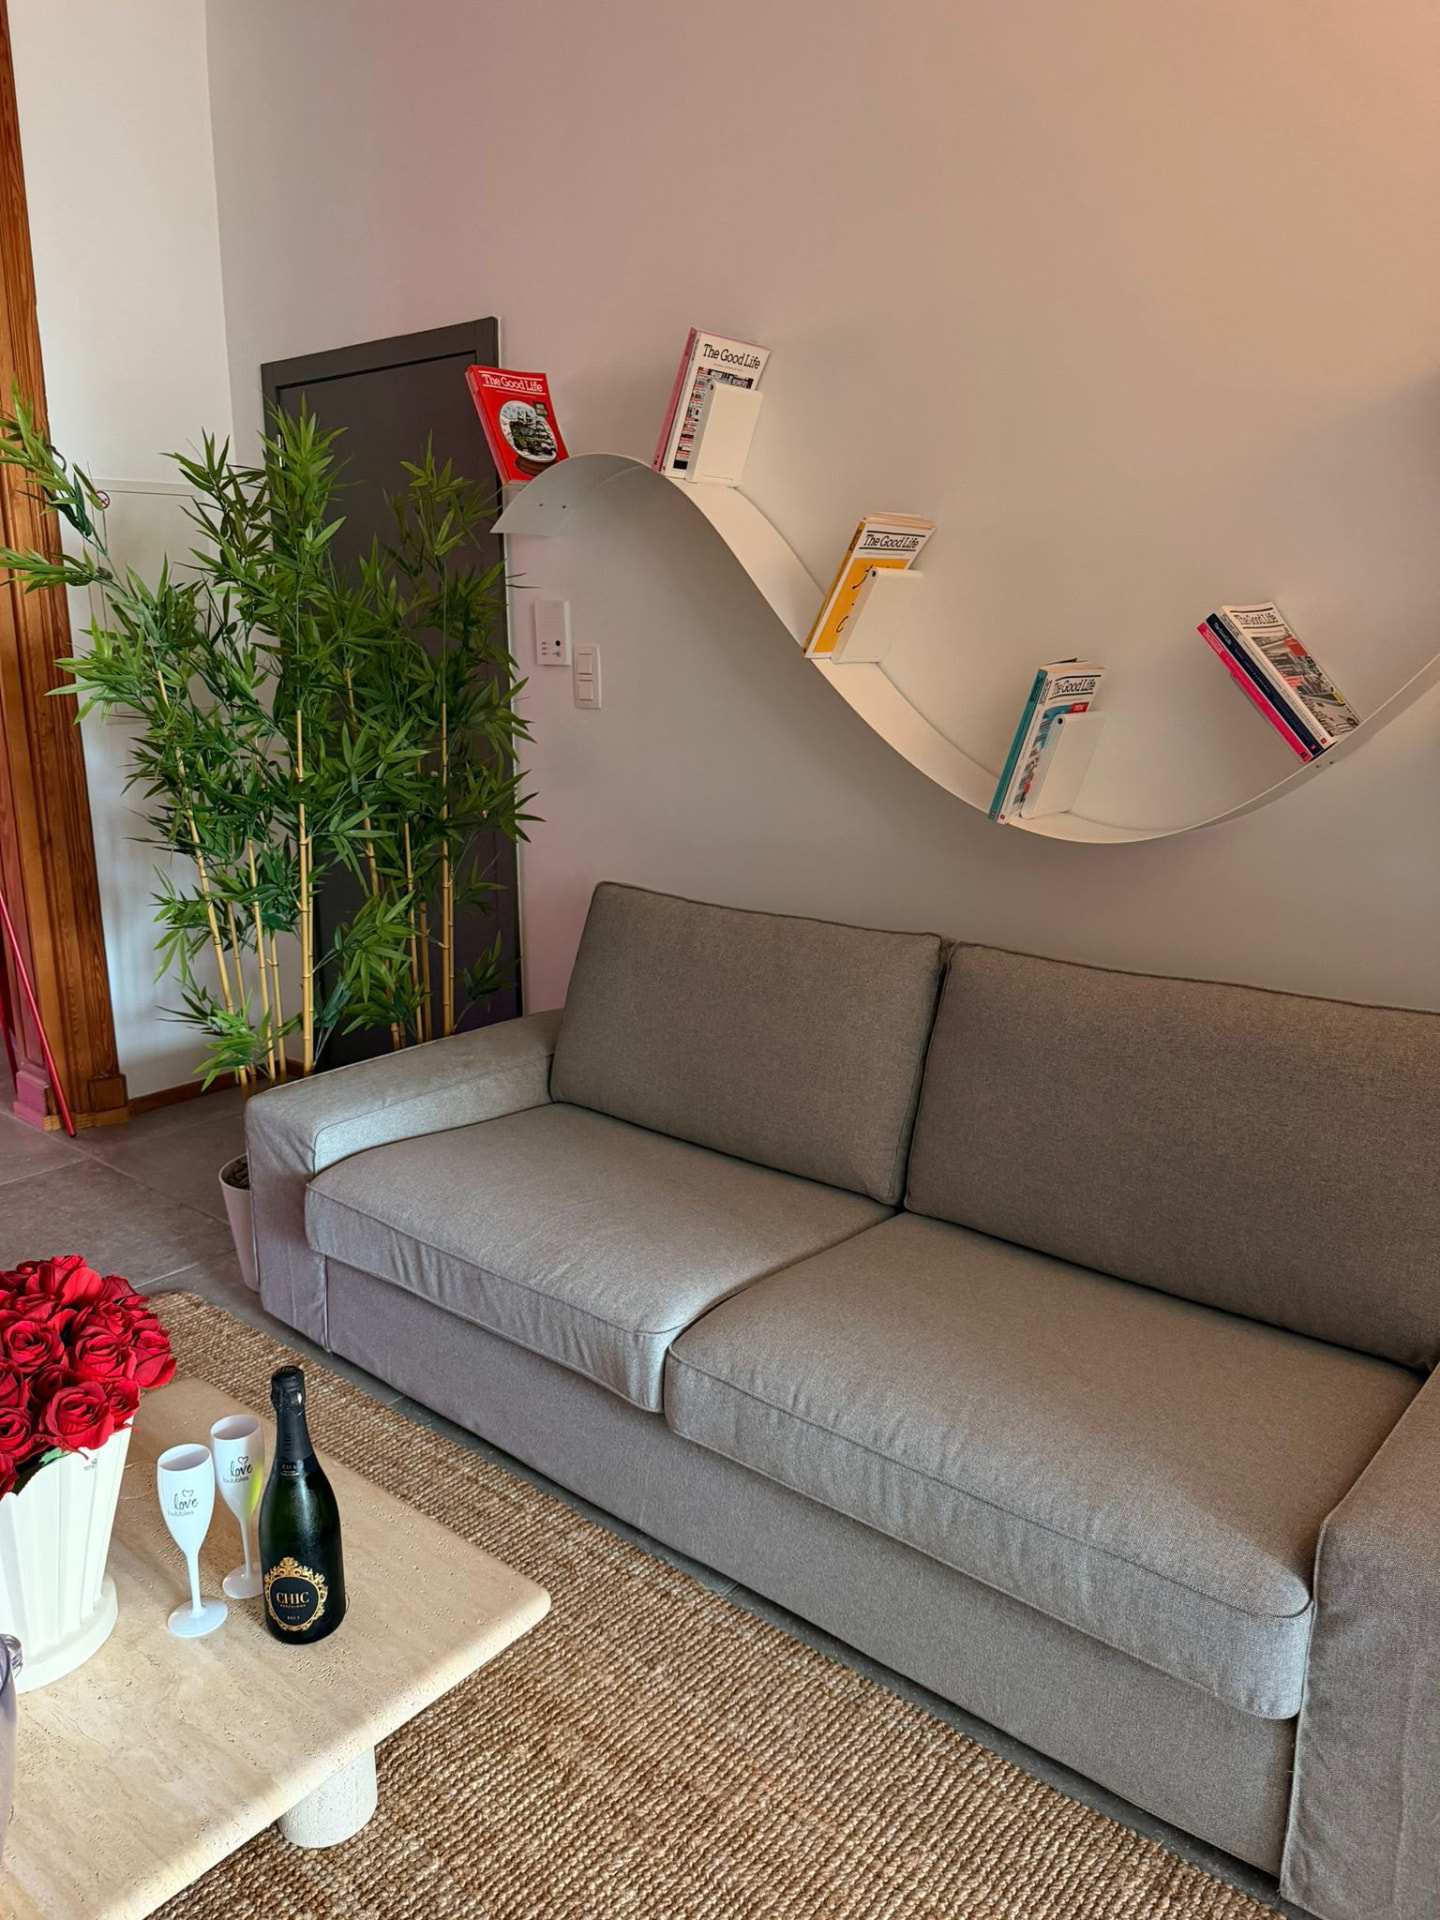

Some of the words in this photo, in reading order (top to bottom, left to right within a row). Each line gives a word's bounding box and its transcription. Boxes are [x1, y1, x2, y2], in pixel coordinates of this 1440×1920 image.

[703, 343, 720, 359] The
[720, 348, 746, 365] Good
[744, 354, 761, 369] Life
[481, 373, 501, 386] The
[500, 376, 525, 390] Good
[524, 380, 543, 392] Life
[863, 533, 881, 546] The
[880, 535, 904, 548] Good
[902, 537, 920, 548] Life
[1062, 679, 1083, 693] Good
[1081, 678, 1096, 691] Life
[230, 1460, 253, 1477] love
[173, 1493, 199, 1511] love
[276, 1591, 310, 1605] CHIC
